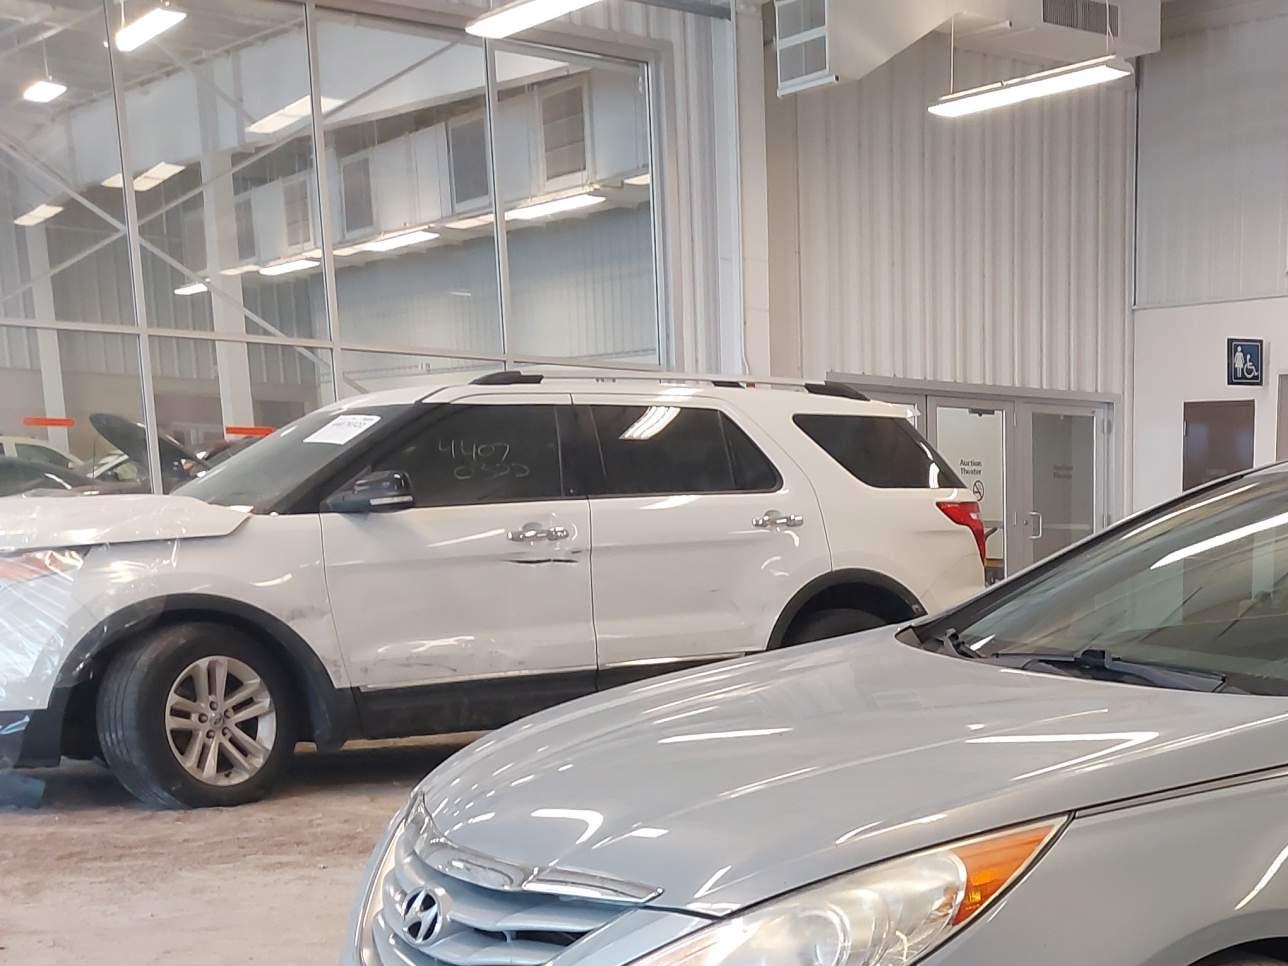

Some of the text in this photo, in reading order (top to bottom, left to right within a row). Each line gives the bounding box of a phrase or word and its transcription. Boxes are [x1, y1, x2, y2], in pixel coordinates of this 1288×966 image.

[438, 439, 511, 461] 4407
[959, 458, 983, 467] Auction
[960, 467, 982, 475] Theater
